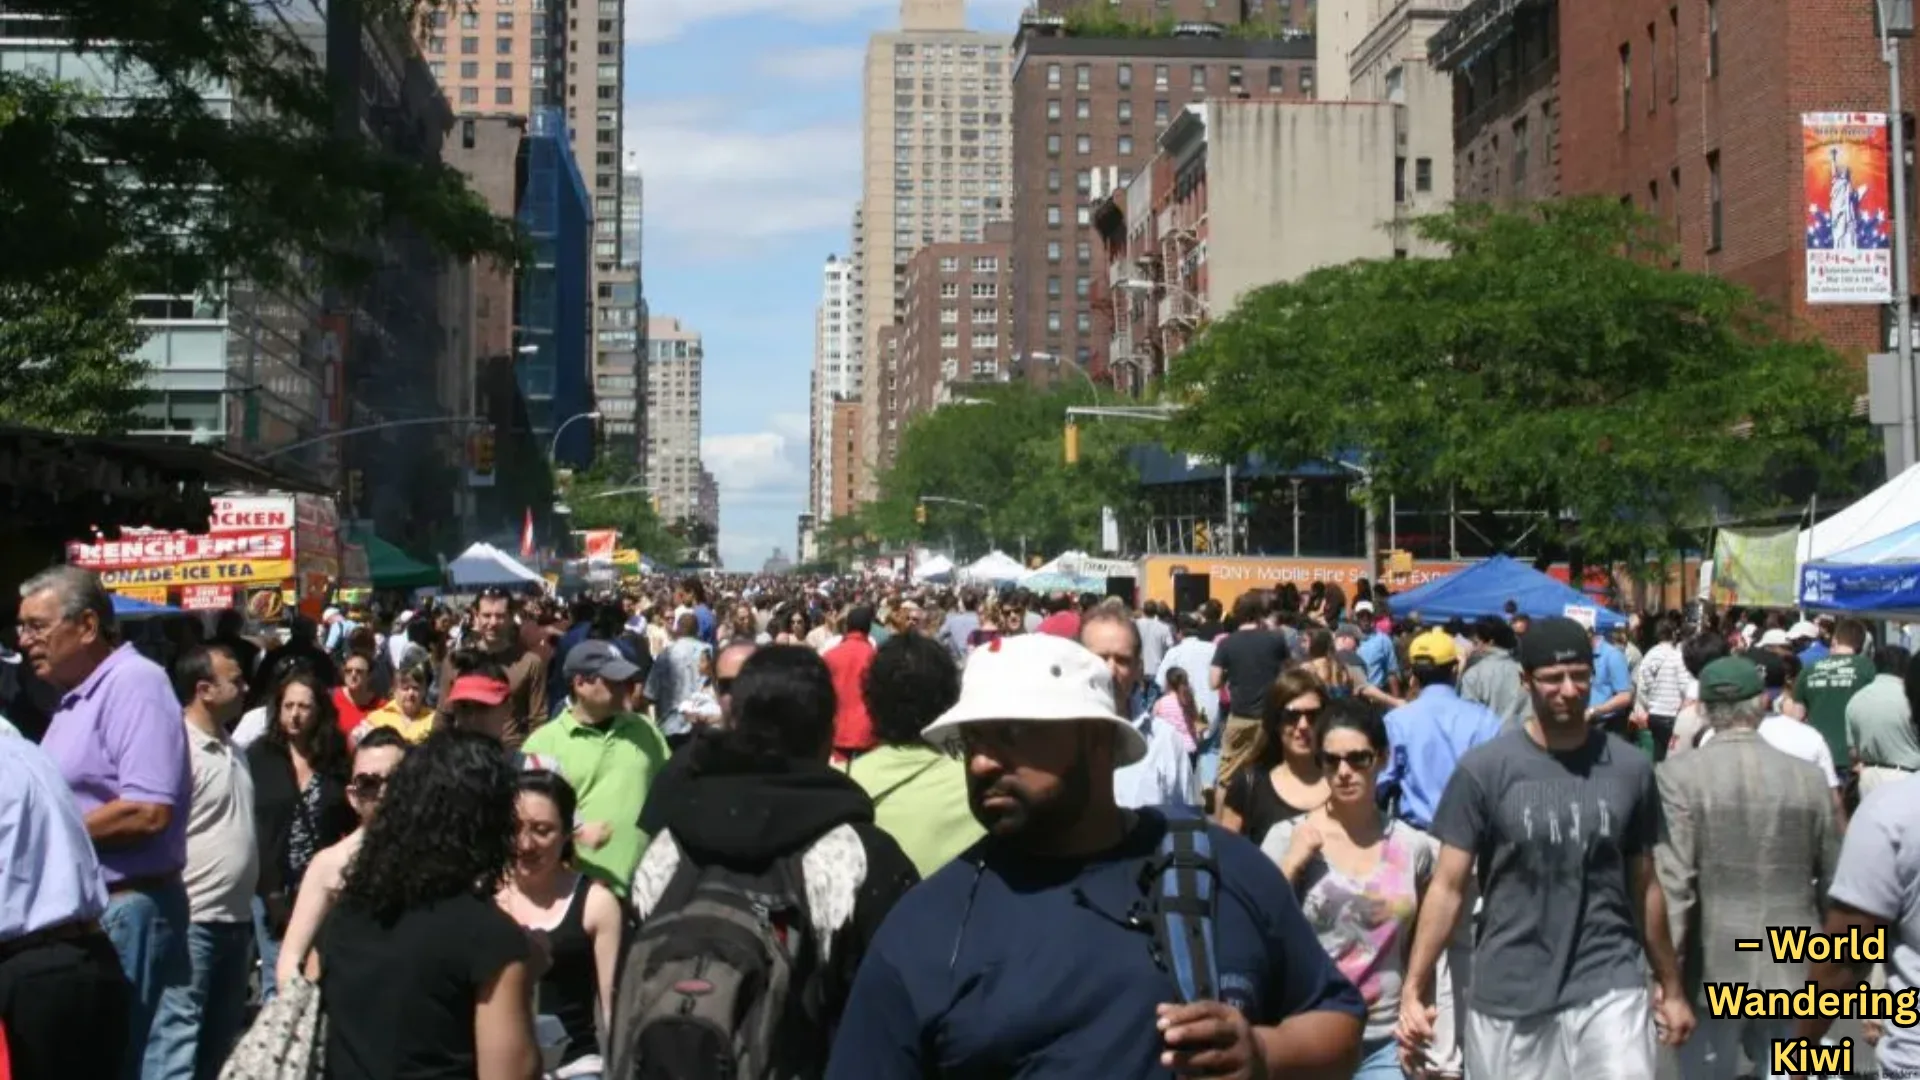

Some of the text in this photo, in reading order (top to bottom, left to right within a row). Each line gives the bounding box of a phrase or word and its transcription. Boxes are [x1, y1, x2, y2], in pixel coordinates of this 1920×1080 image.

[211, 512, 285, 526] ICKEN
[198, 534, 285, 556] FRIES
[103, 563, 253, 583] ONADE-ICE TEA
[1211, 565, 1253, 580] FDNY
[1258, 566, 1310, 581] Mobile
[1314, 567, 1344, 582] Fire
